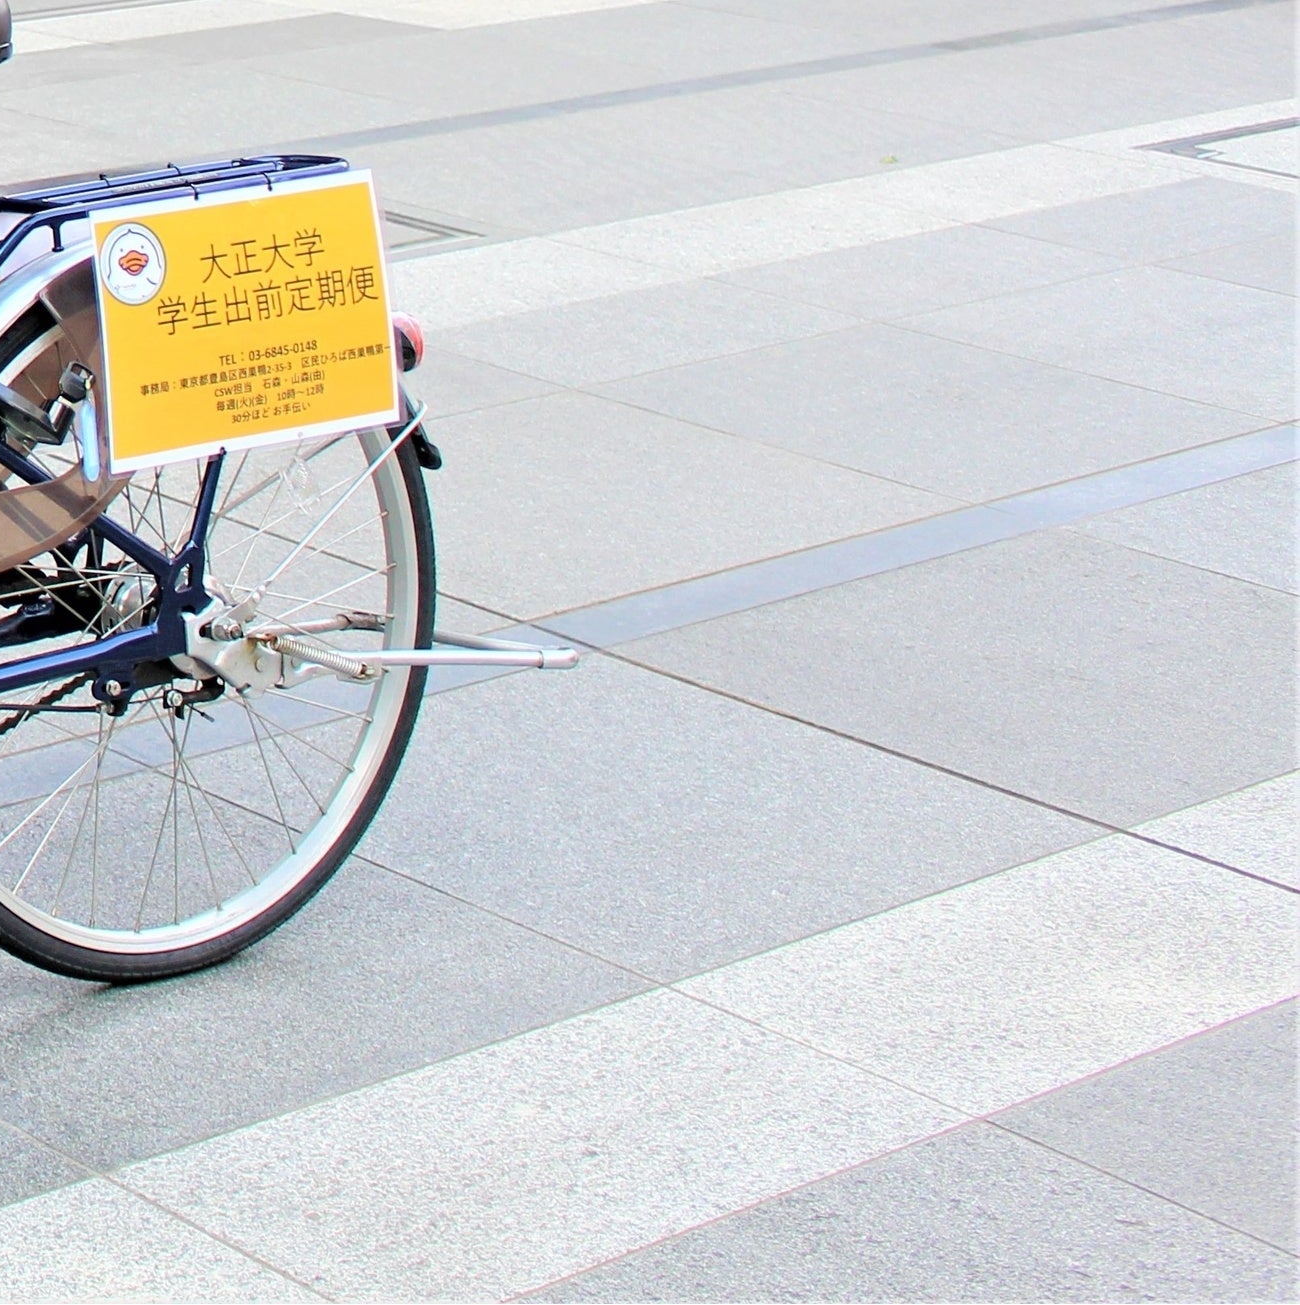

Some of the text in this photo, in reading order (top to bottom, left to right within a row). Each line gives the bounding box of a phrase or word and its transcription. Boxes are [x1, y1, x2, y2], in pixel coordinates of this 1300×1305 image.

[200, 227, 325, 283] 大正大学
[157, 265, 379, 336] 学生出前定期便
[214, 381, 253, 397] CSW担当
[231, 402, 311, 424] 30分ほど お手伝い
